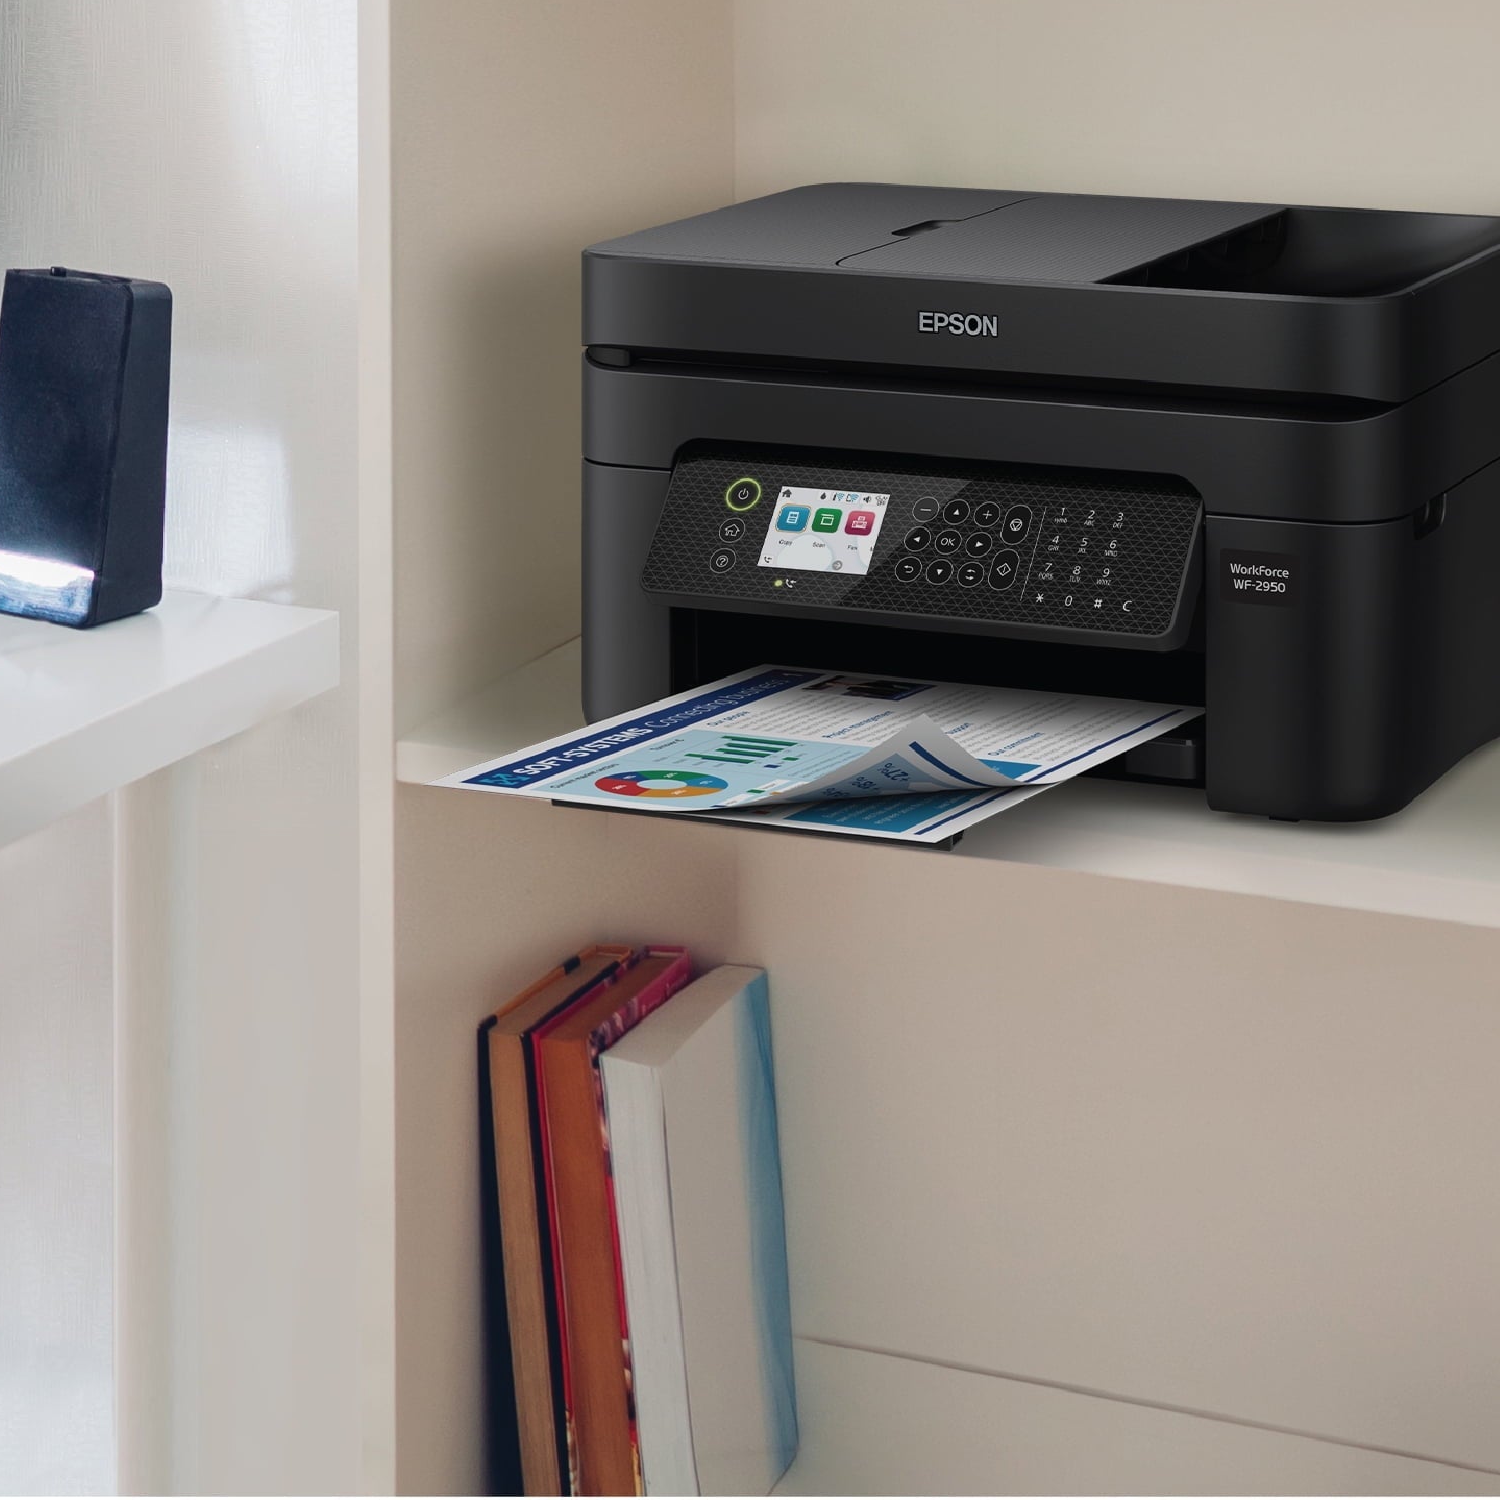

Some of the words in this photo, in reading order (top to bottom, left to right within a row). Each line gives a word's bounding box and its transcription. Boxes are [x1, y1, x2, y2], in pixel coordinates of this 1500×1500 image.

[919, 311, 998, 337] EPSON
[1088, 510, 1096, 520] 2
[1117, 512, 1124, 522] 3
[940, 537, 956, 547] OK
[1052, 535, 1060, 544] 4
[1080, 537, 1088, 547] 5
[1109, 539, 1118, 549] 6
[1044, 562, 1053, 572] 7
[1072, 565, 1081, 575] 8
[1230, 563, 1289, 578] WorkForce
[1102, 567, 1110, 578] 9
[1233, 578, 1286, 593] WF-2950
[513, 727, 653, 775] SOFT-SYSTEMS
